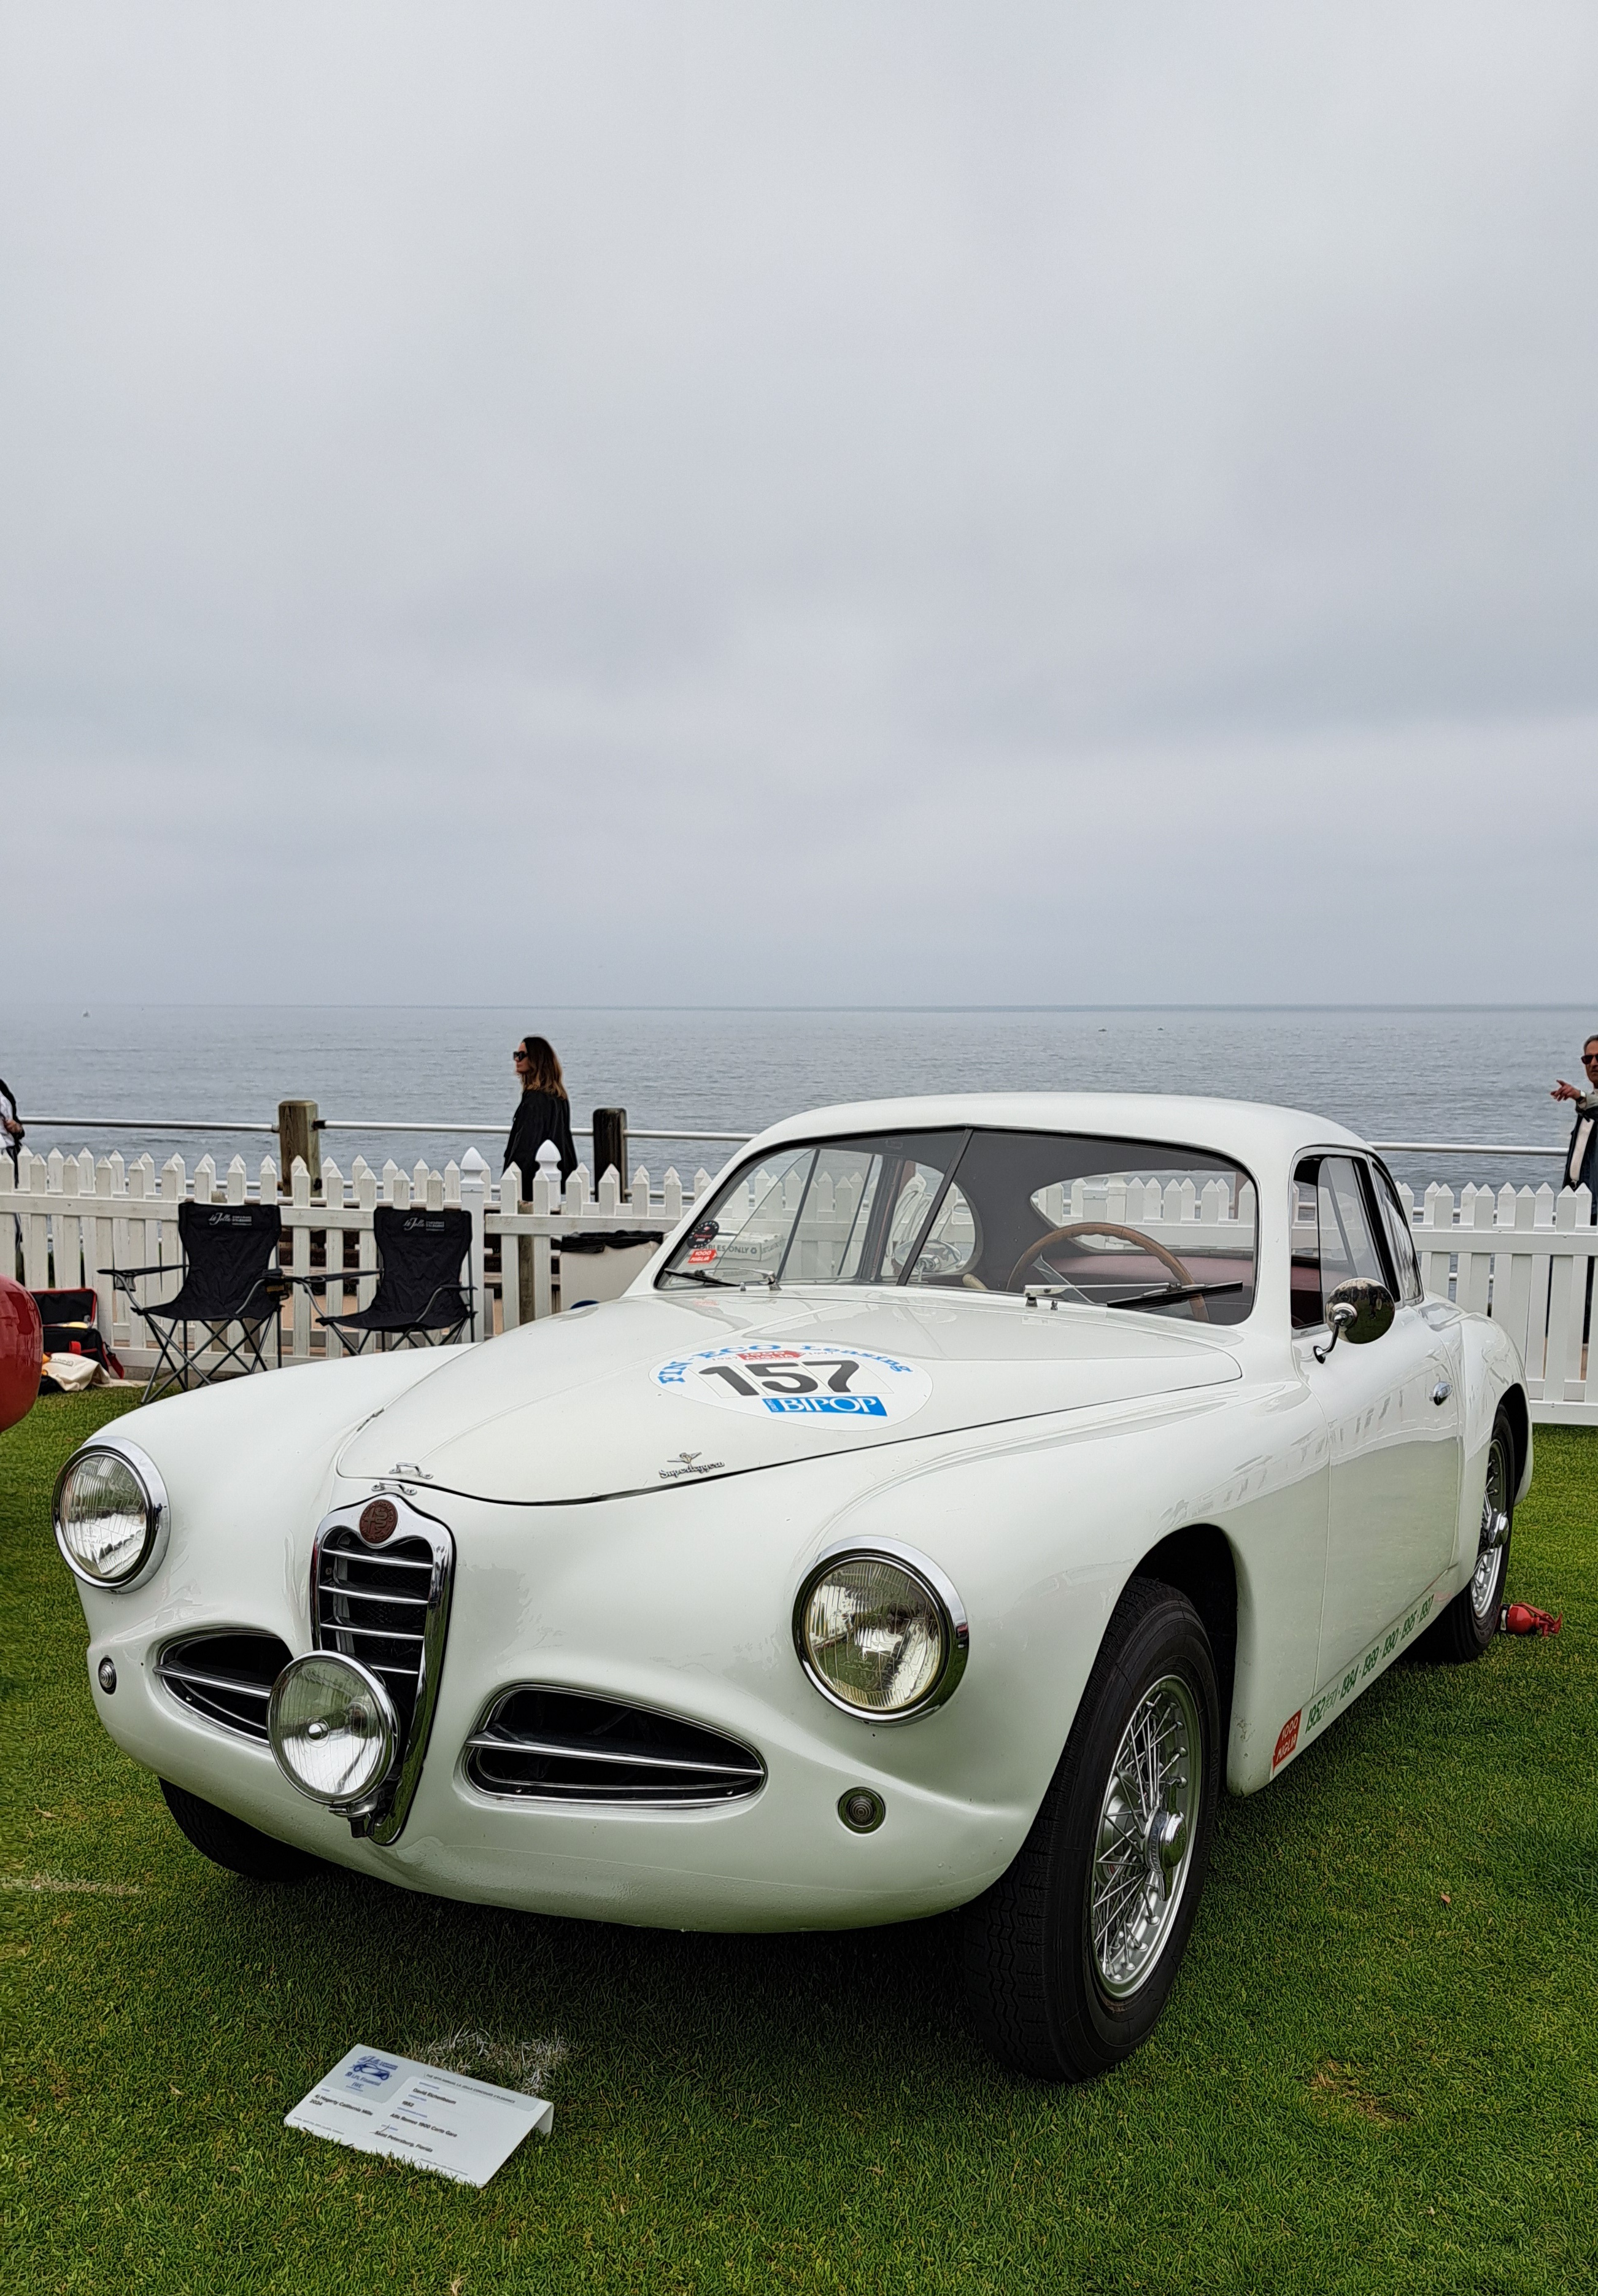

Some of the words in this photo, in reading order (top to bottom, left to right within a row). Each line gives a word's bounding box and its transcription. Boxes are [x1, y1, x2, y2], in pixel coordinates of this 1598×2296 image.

[658, 1344, 781, 1384] FIN-ECO
[800, 1345, 913, 1372] Leasing
[698, 1360, 859, 1396] 157
[777, 1397, 877, 1413] BIPOP
[1281, 1715, 1299, 1741] 1000
[320, 2096, 339, 2105] Hagerty
[339, 2102, 361, 2112] California
[400, 2116, 418, 2125] Romeo
[415, 2144, 433, 2152] Florida
